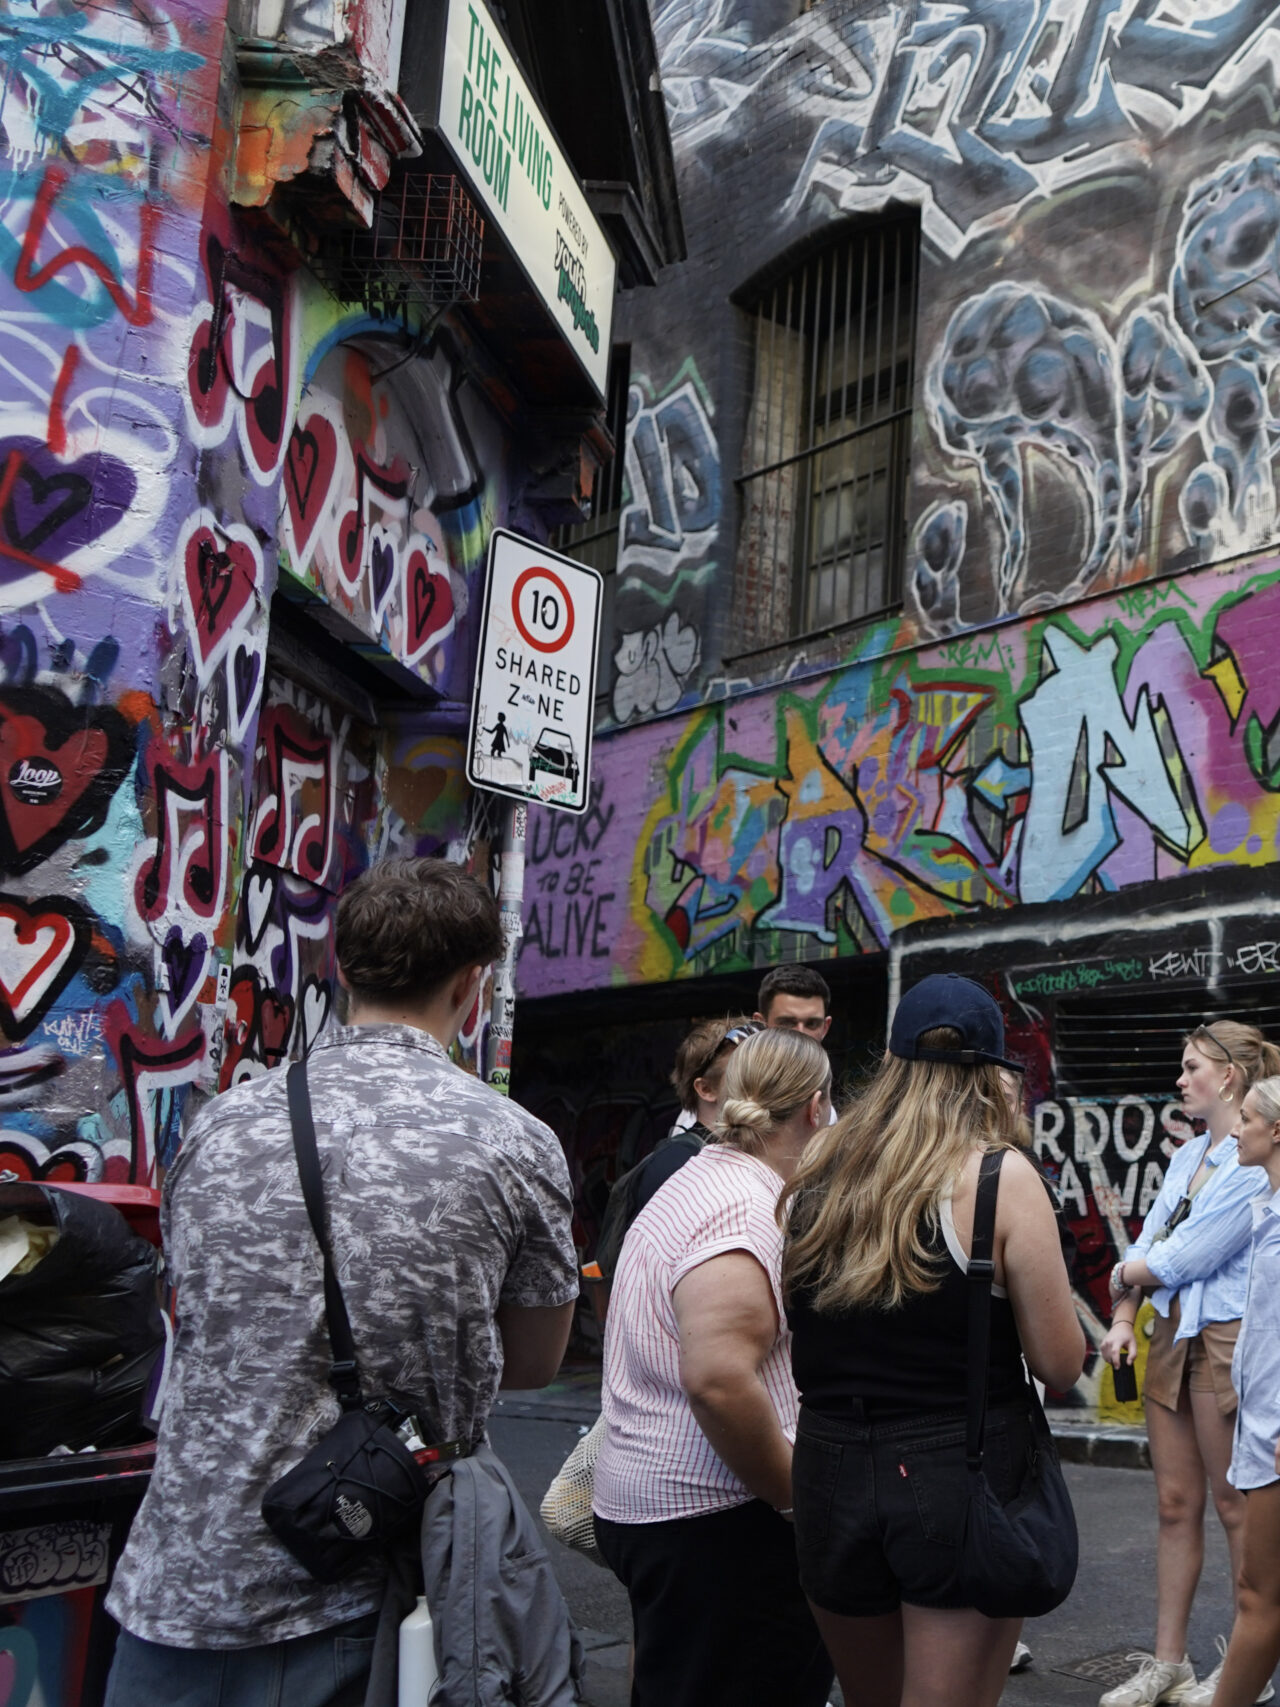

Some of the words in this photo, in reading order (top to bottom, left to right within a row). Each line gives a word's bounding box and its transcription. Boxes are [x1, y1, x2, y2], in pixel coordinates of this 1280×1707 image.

[467, 2, 501, 120] THE
[503, 74, 553, 211] LIVING
[459, 73, 511, 213] ROOM
[558, 192, 581, 247] POWERED
[555, 228, 587, 304] youth
[531, 590, 560, 630] 10
[495, 648, 581, 696] SHARED
[564, 860, 602, 895] BE
[517, 893, 615, 959] ALIVE
